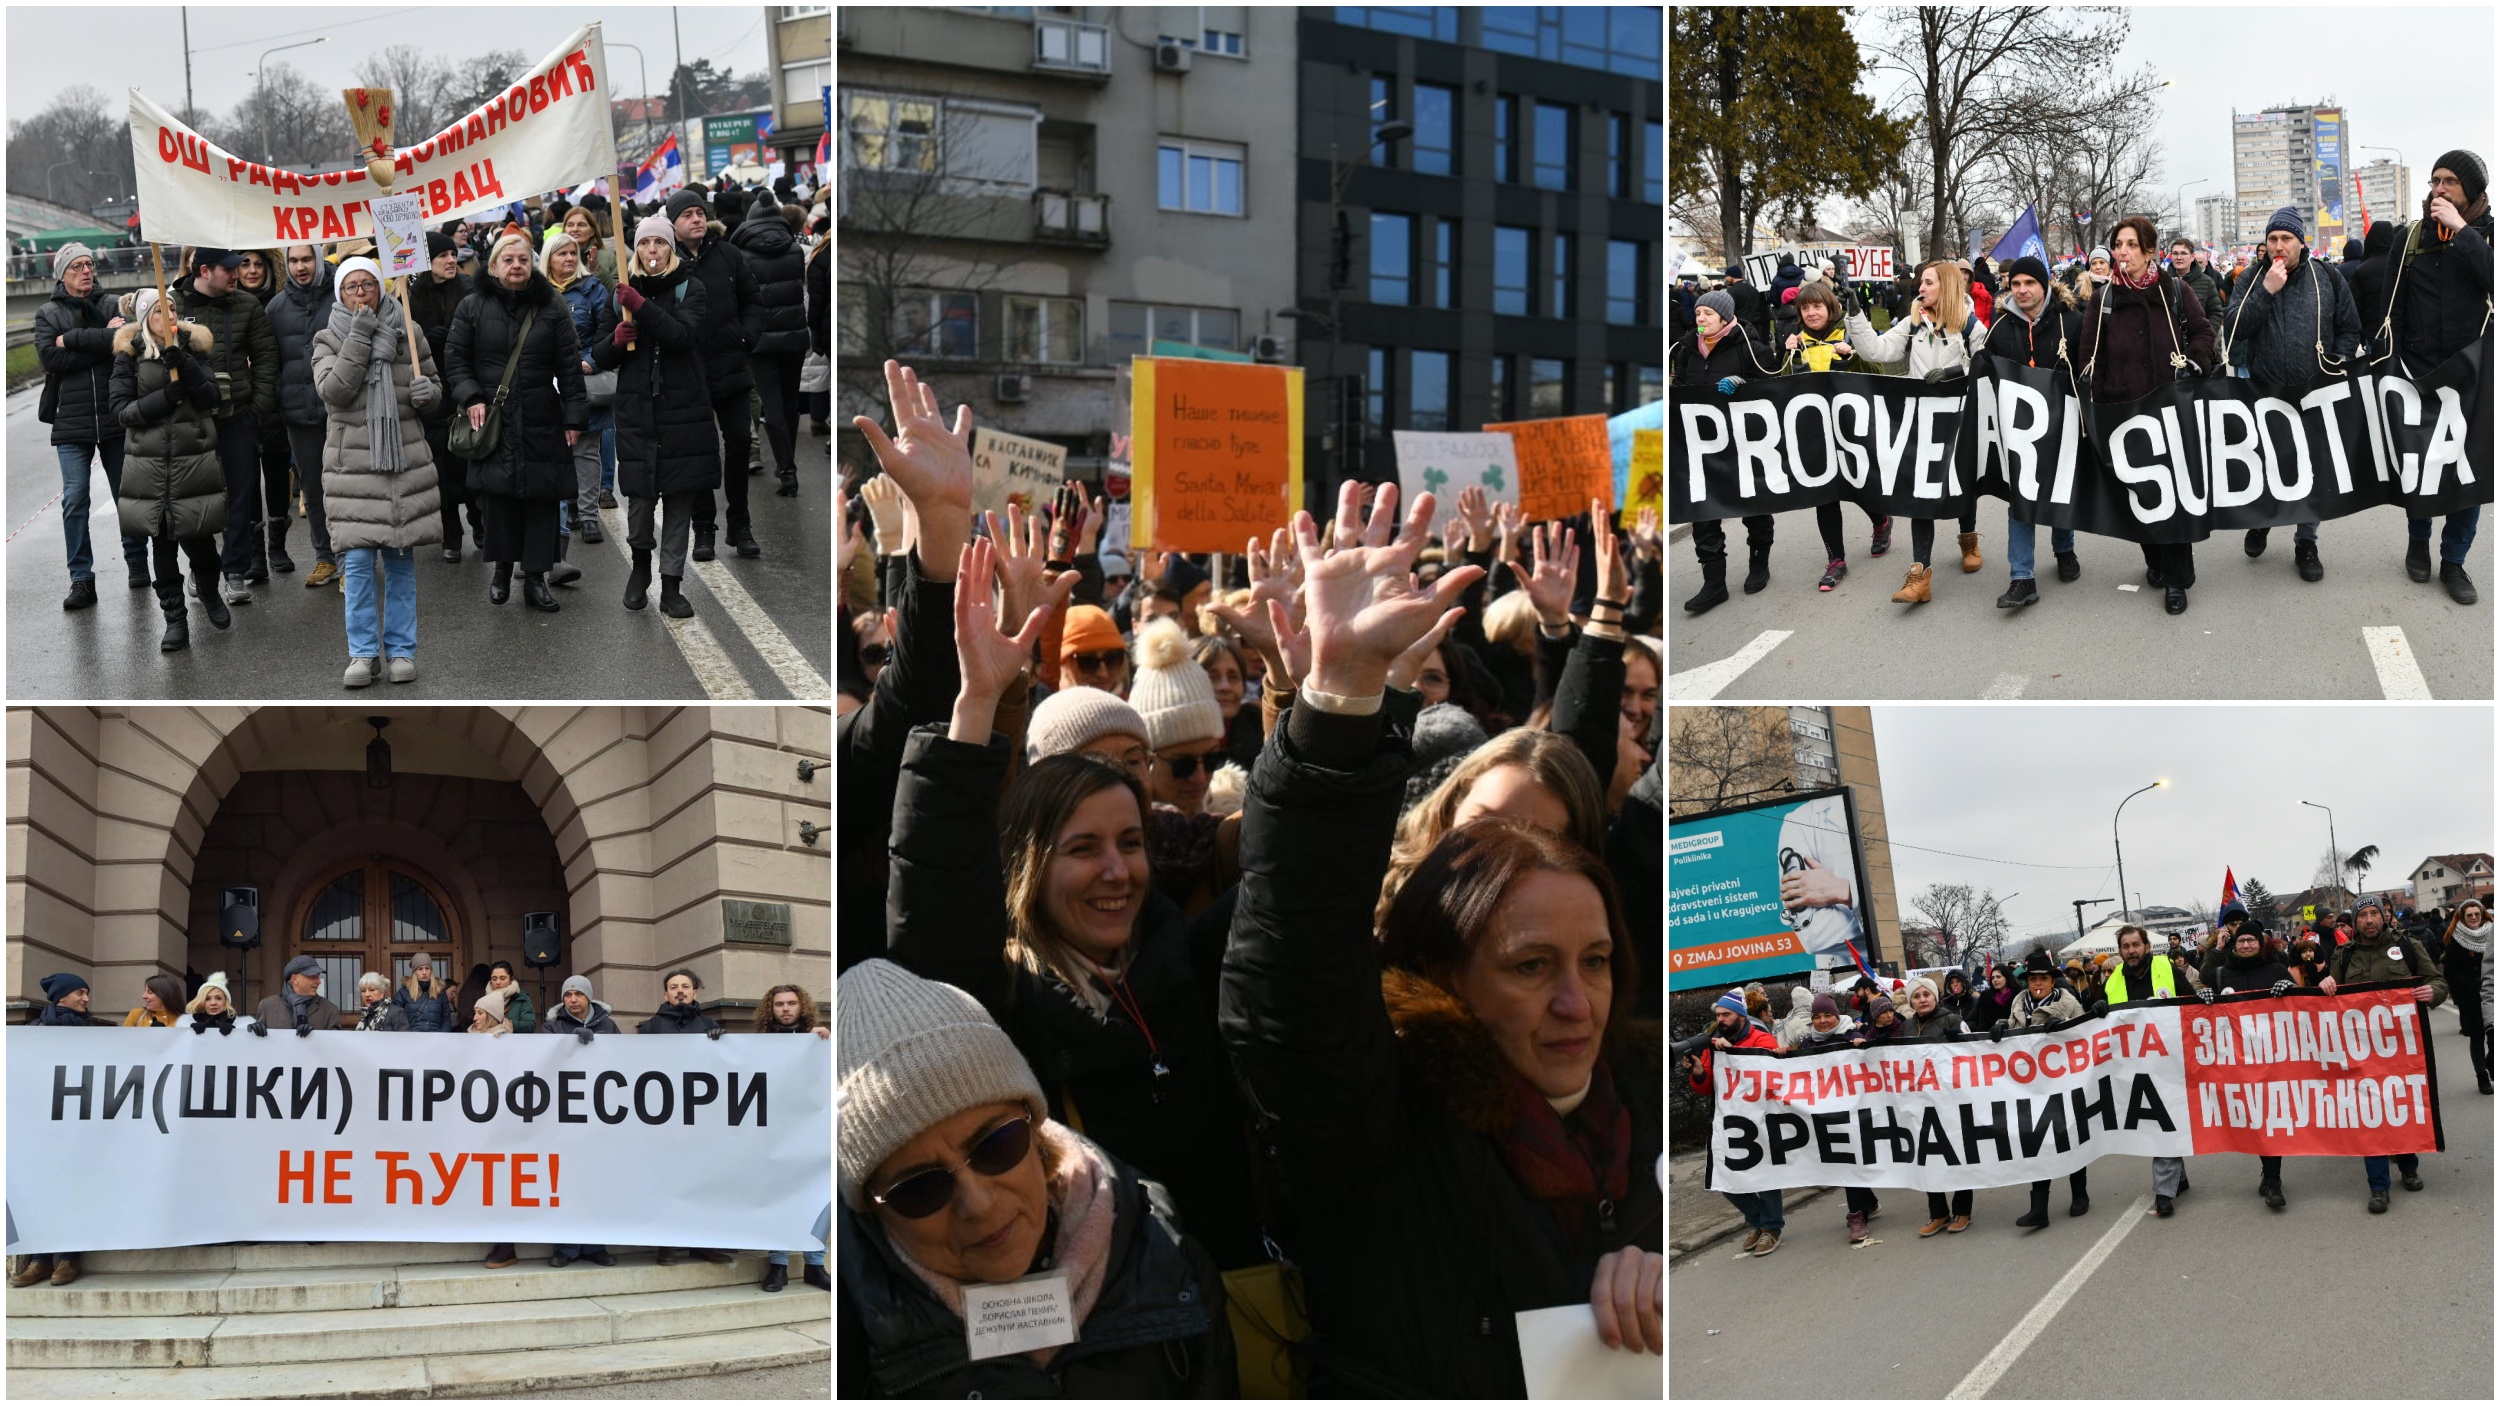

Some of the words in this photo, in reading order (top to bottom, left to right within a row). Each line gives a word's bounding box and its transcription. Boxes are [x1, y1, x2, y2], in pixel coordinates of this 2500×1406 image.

[158, 126, 211, 175] ОШ
[272, 158, 504, 240] КРАГВАЦ
[1845, 248, 1892, 278] ЗУБЕ
[1173, 393, 1218, 421] Наше
[975, 454, 991, 470] СА
[2109, 374, 2477, 525] SUBOTICA
[1174, 472, 1226, 494] Santa
[1176, 502, 1216, 523] della
[1222, 496, 1277, 524] Salute
[1671, 835, 1720, 851] MEDIGROUP
[1673, 852, 1712, 866] Poliklinika
[1701, 877, 1741, 895] privatni
[1725, 890, 1759, 905] sistem
[1683, 911, 1706, 924] sada
[1708, 909, 1712, 921] i
[1713, 910, 1720, 919] u
[1722, 901, 1779, 919] Kragujevcu
[1687, 950, 1723, 966] ZMAJ
[1726, 941, 1775, 959] JOVINA
[1777, 937, 1793, 951] 53
[2192, 1015, 2237, 1067] ЗА
[2239, 1003, 2417, 1071] МЛАДОСТ
[1722, 1058, 1941, 1106] УЈЕДИЊЕНА
[1952, 1023, 2169, 1090] ПРОСВЕТА
[50, 1063, 353, 1136] НИ(ШКИ)
[377, 1068, 768, 1128] ПРОФЕСОРИ
[2198, 1081, 2223, 1128] И
[2224, 1074, 2428, 1138] БУДУЋНОСТ
[1723, 1072, 2178, 1172] ЗРЕЊАНИНА
[277, 1149, 354, 1204] НЕ
[374, 1150, 561, 1208] ЋУТЕ!
[981, 1297, 1022, 1310] ОСНОВНА
[1023, 1292, 1055, 1305] ШКОЛА
[974, 1322, 1015, 1336] ДЕЖУРНИ
[1017, 1315, 1066, 1330] НАСТАВНИК
